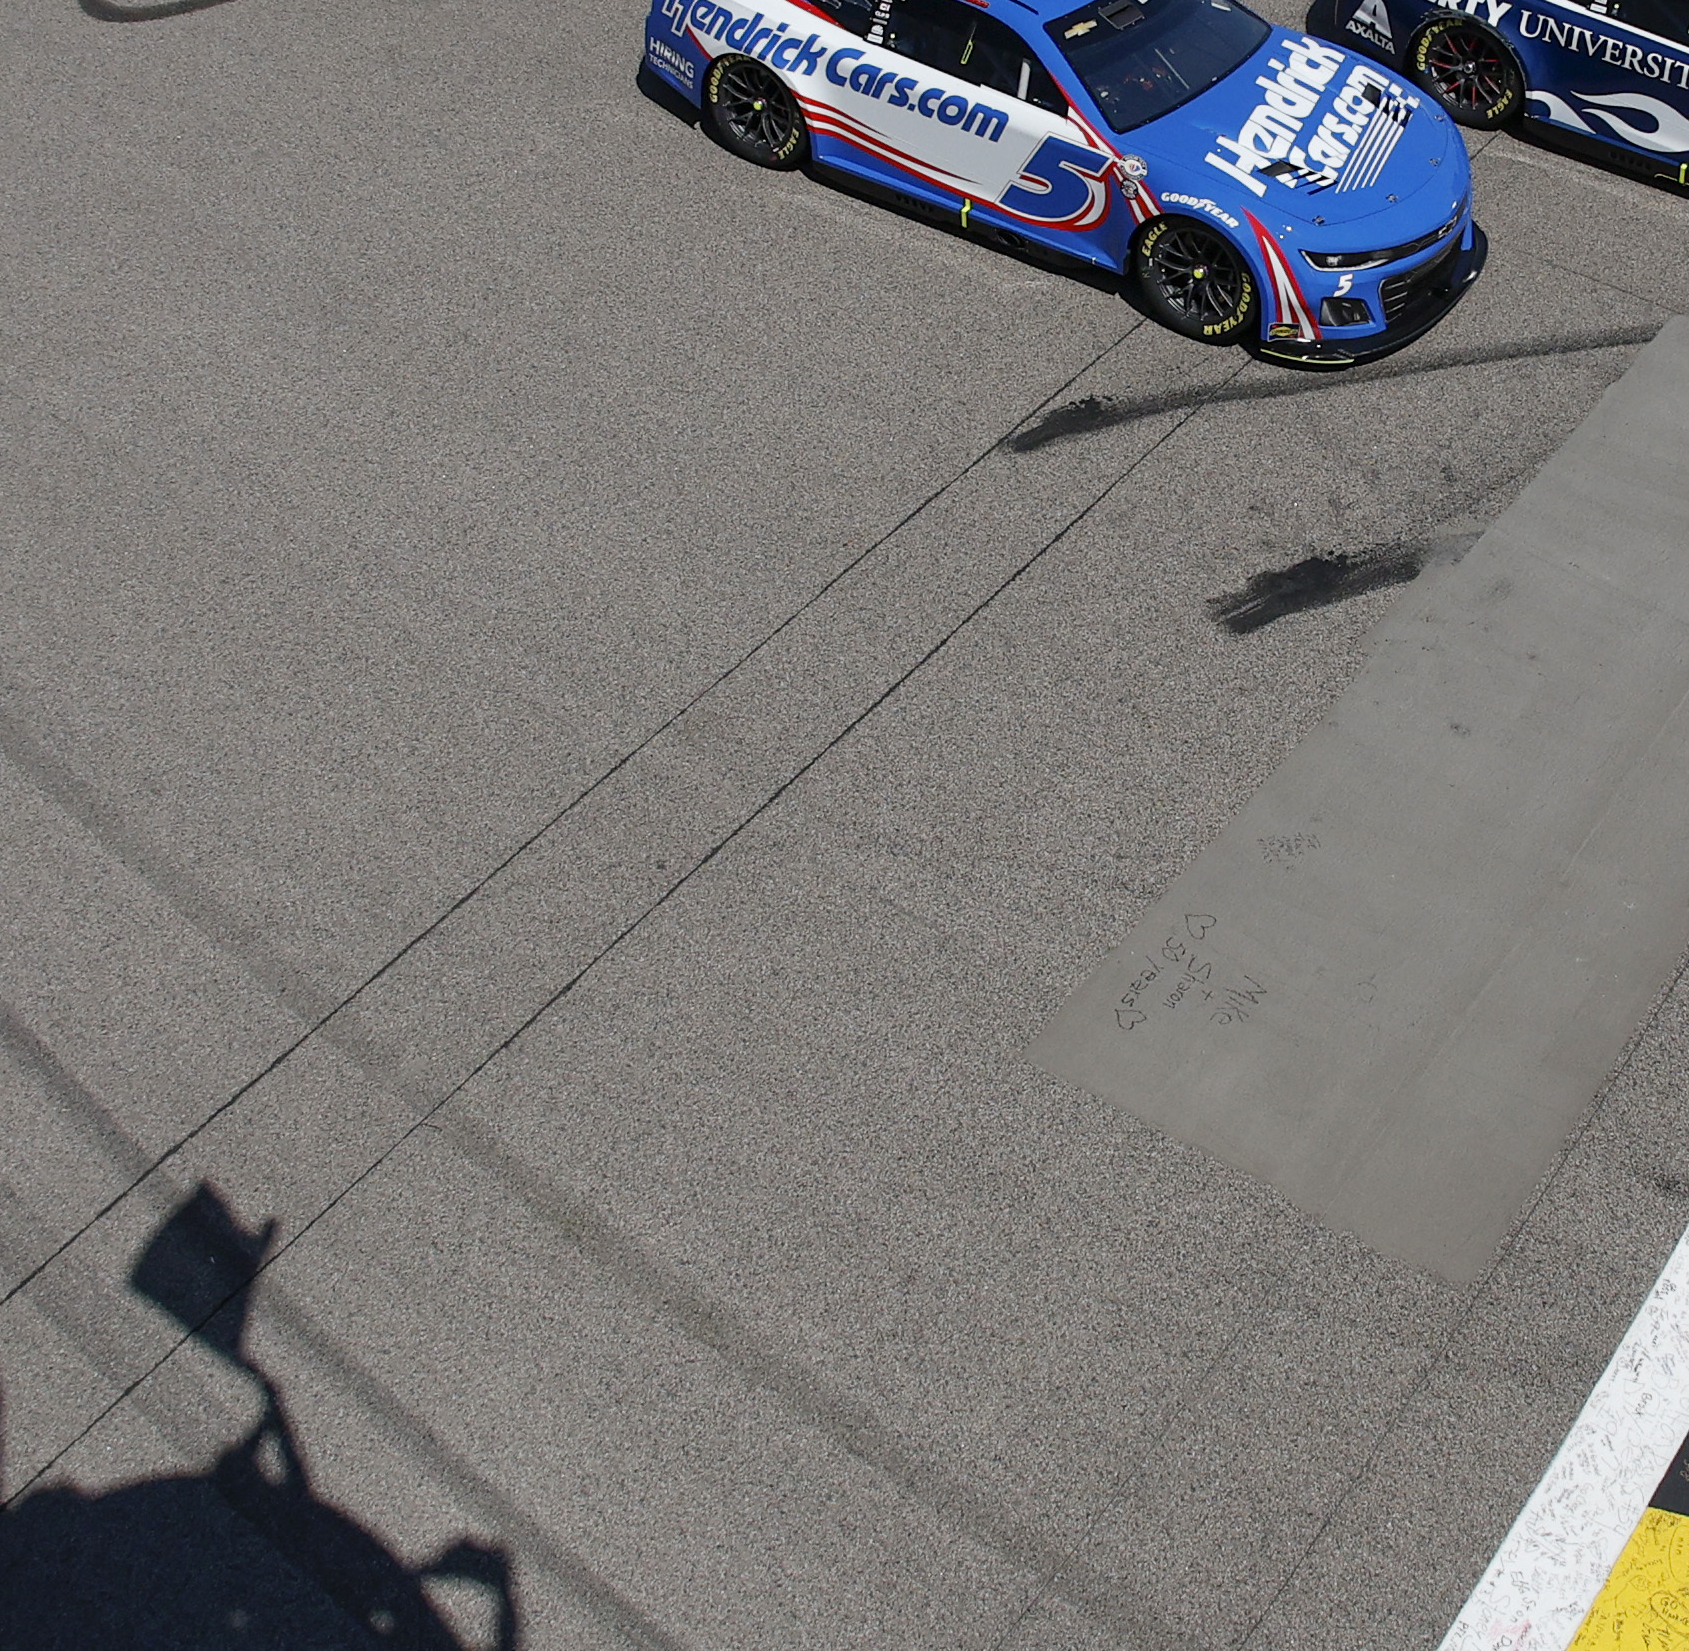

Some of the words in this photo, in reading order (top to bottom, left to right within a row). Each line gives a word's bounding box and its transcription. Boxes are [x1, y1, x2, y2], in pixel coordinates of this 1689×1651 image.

[1345, 19, 1396, 55] AXALTA
[1416, 18, 1464, 72] GOODYEAR
[649, 37, 696, 79] HIRING
[649, 53, 694, 89] TECHNICIANS
[1205, 37, 1346, 198] Hendrick
[1486, 89, 1513, 120] EAGLE
[777, 128, 800, 160] EAGLE
[994, 133, 1114, 221] 5
[1161, 191, 1240, 229] GOODYEAR
[1141, 221, 1169, 258] EAGLE
[1203, 271, 1250, 337] GOODYEAR
[1334, 274, 1354, 298] 5
